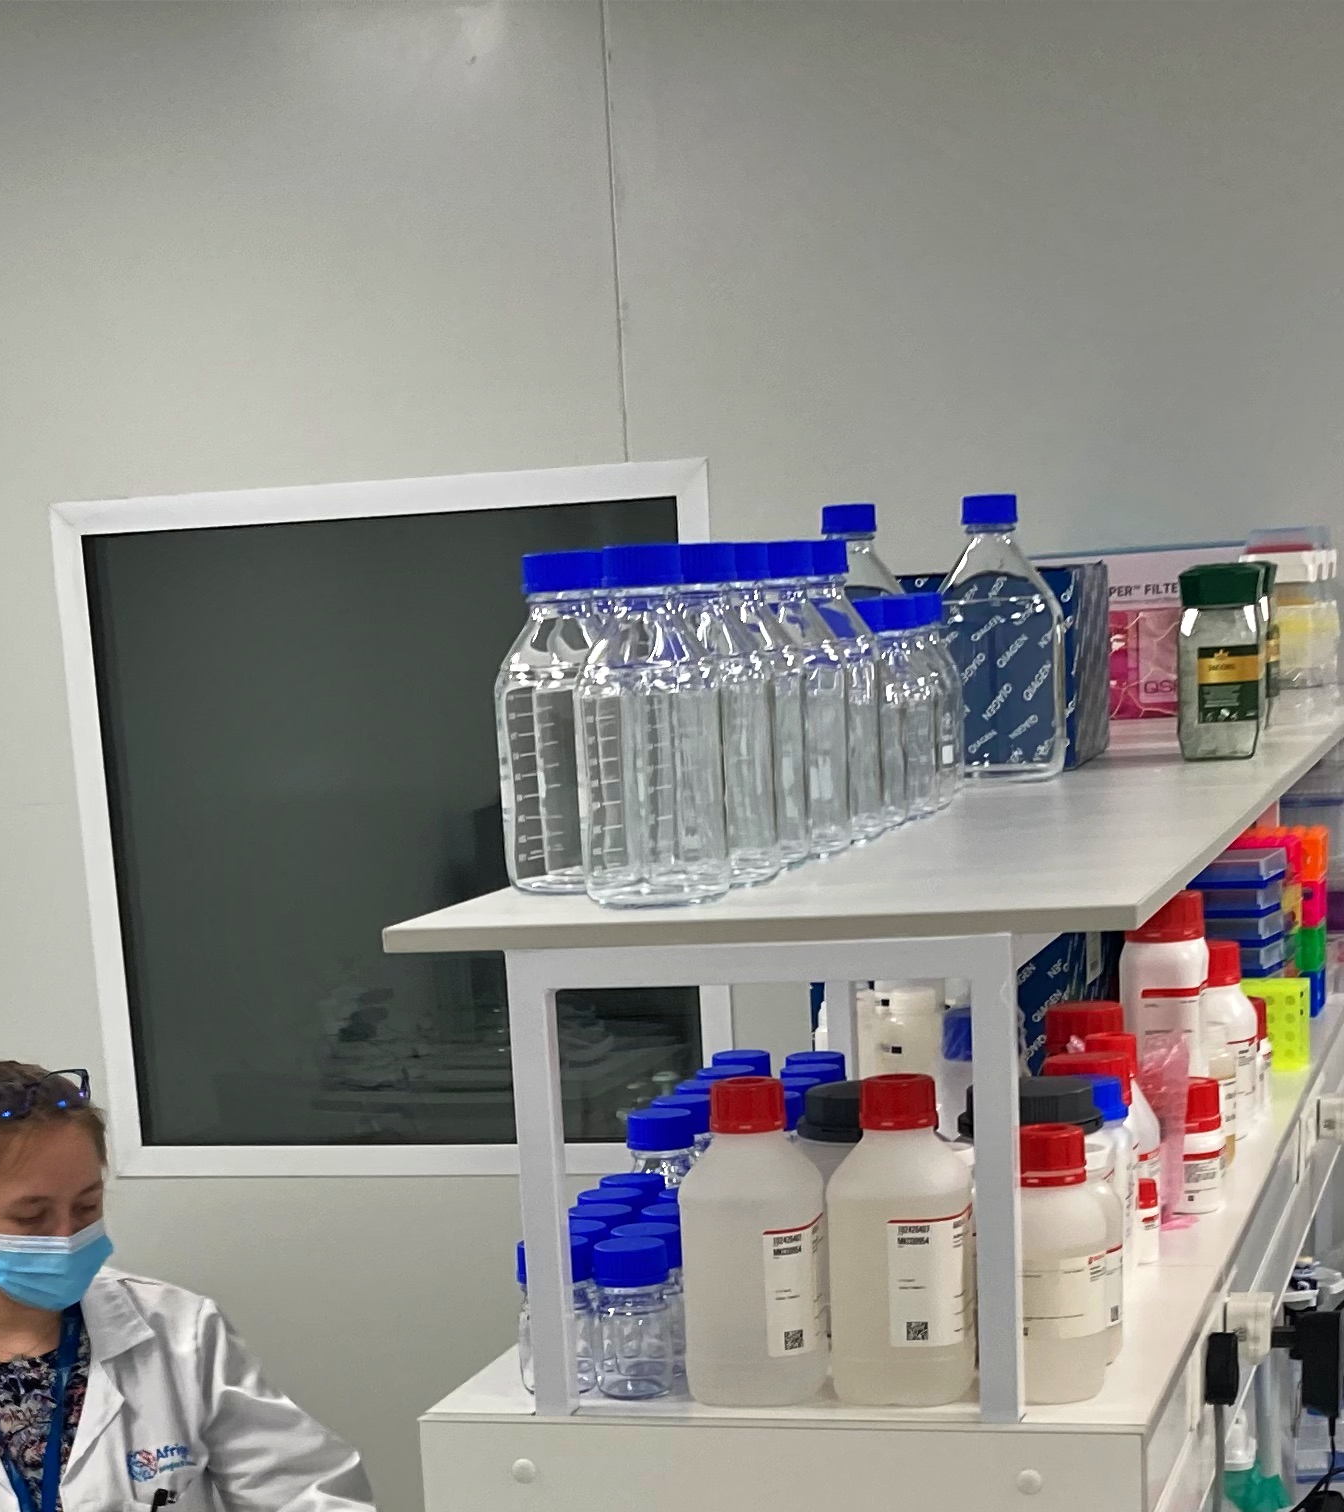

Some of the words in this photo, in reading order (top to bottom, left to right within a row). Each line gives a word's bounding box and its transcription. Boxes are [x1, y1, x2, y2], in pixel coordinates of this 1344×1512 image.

[961, 652, 986, 685] QIAGE
[997, 633, 1030, 669] QIAGEN
[1023, 660, 1052, 701] QIAGEN
[982, 682, 1013, 721] QIAGEN
[968, 729, 998, 754] QIAGEN
